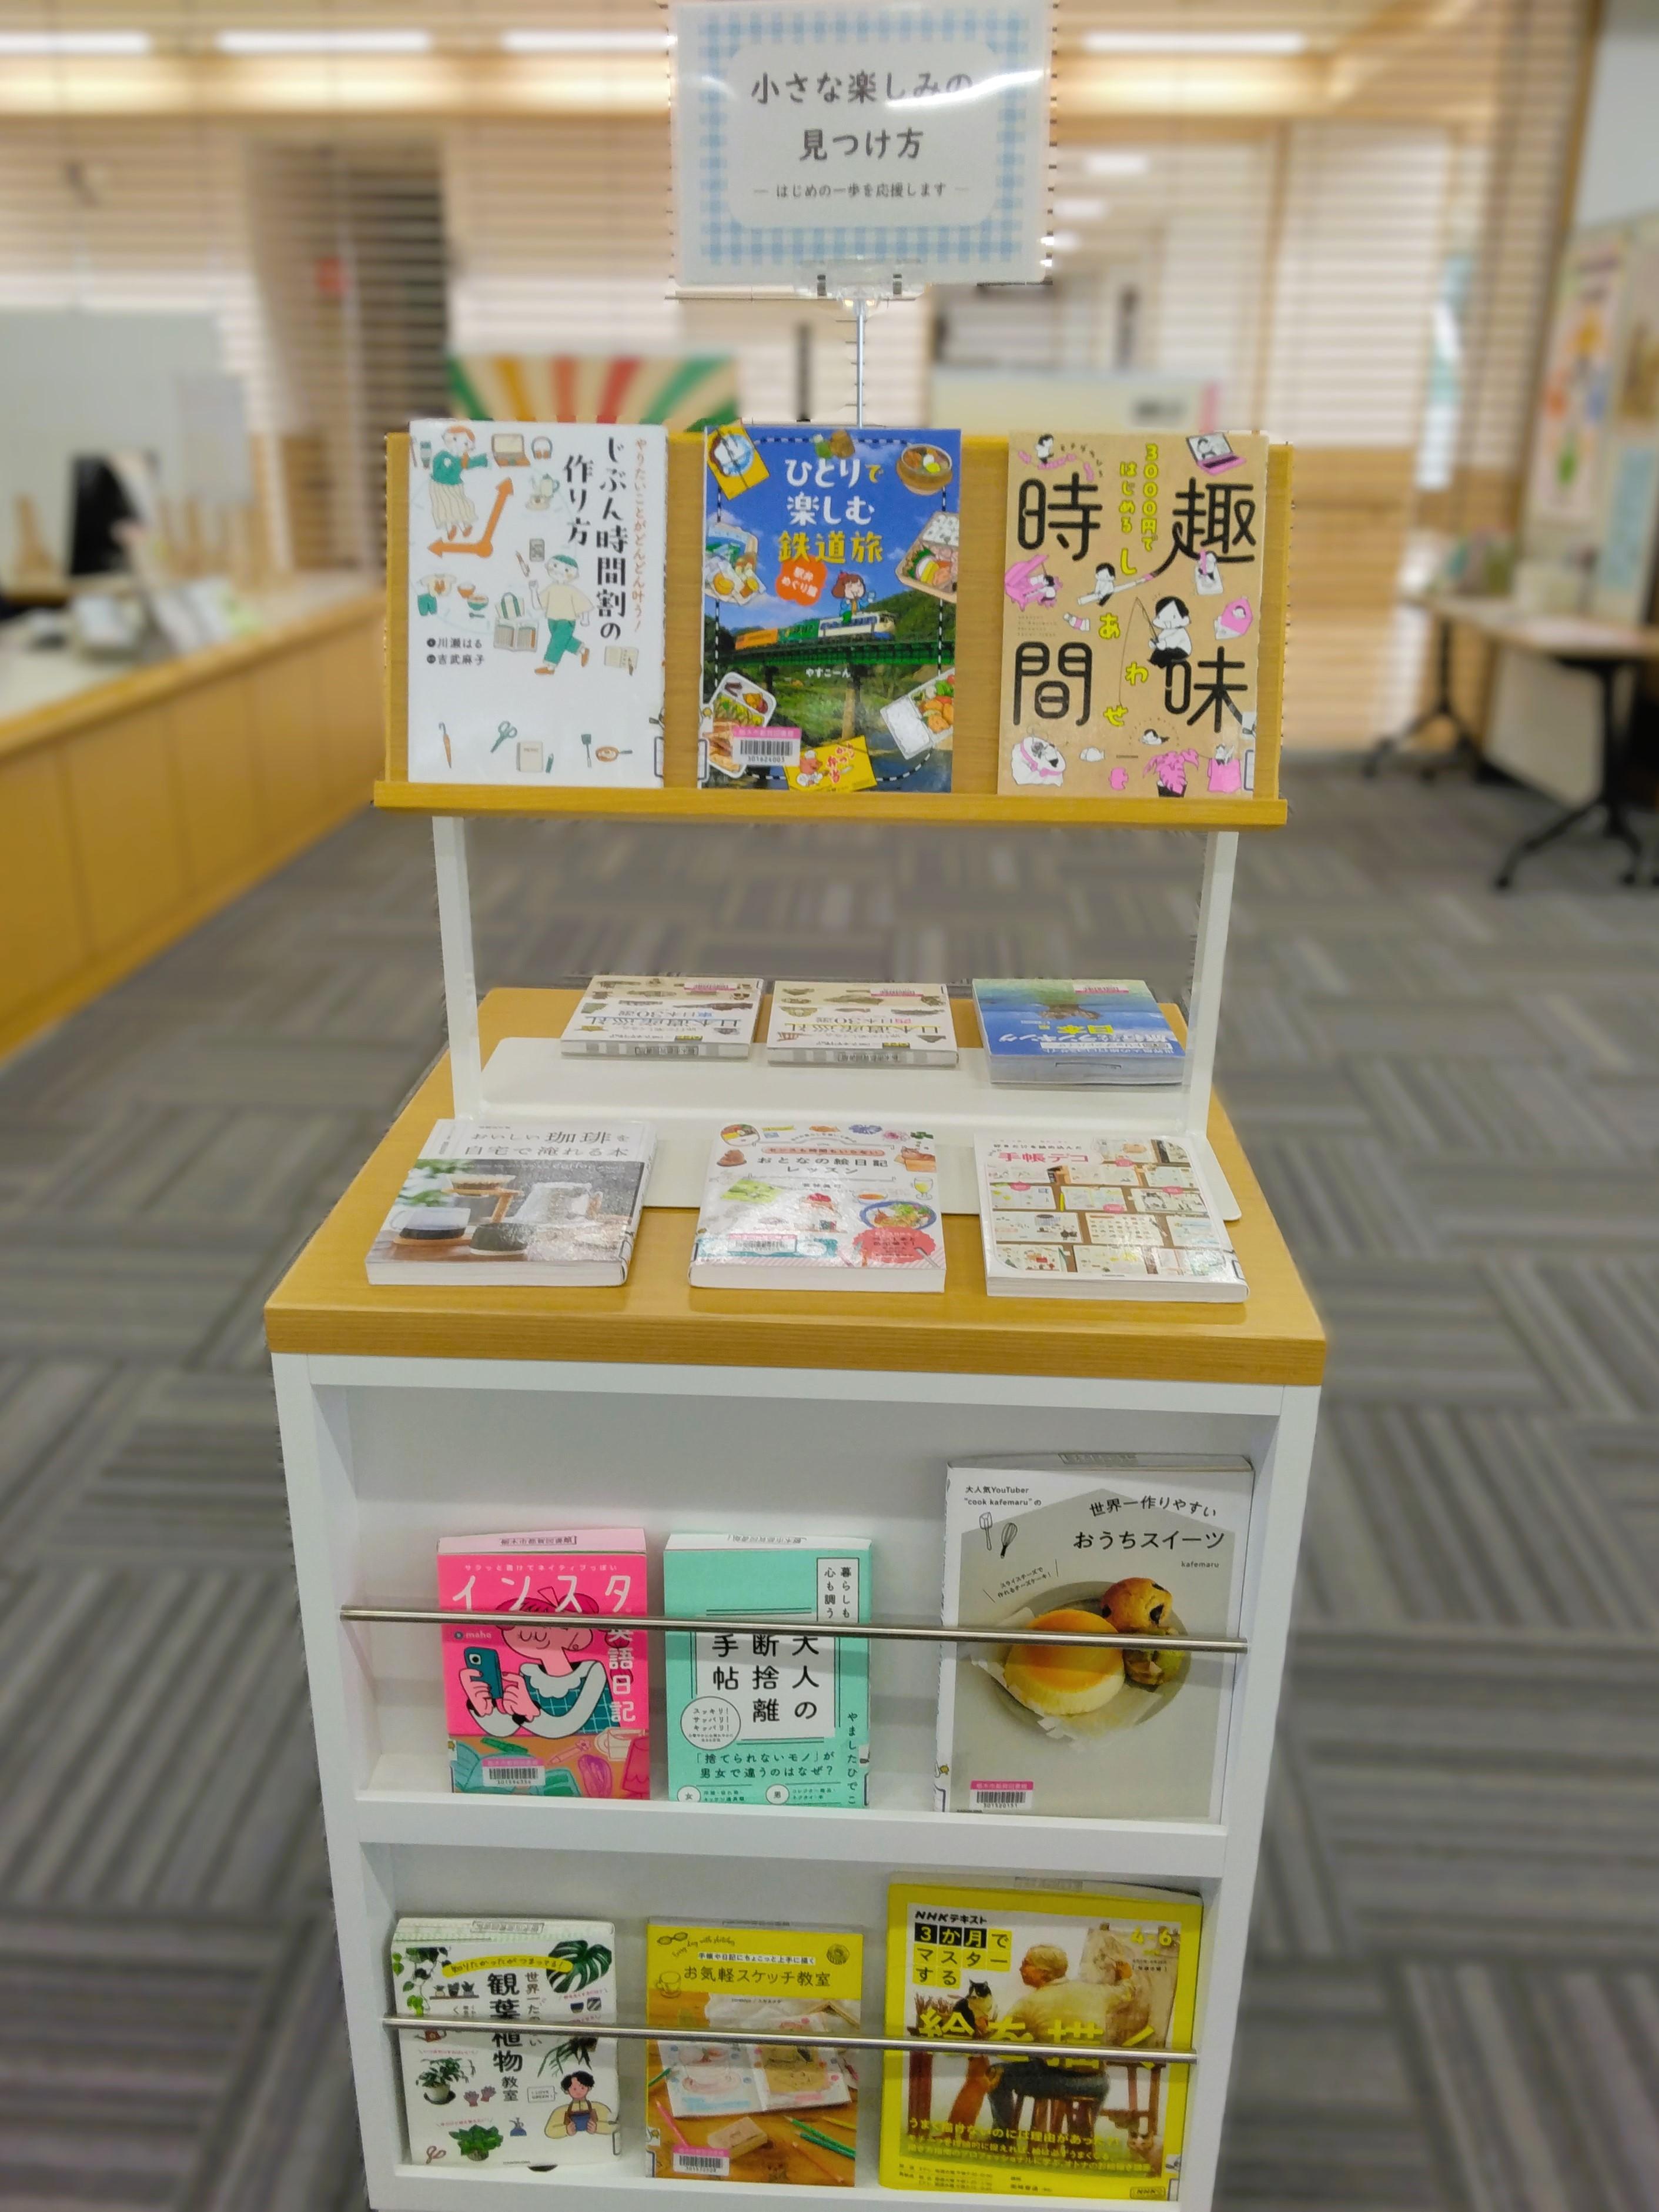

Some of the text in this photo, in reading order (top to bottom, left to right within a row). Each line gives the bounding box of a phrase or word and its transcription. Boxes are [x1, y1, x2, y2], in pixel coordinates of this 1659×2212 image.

[751, 70, 974, 104] 小さな楽しみの
[800, 128, 924, 161] 見つけ方
[775, 182, 946, 198] はじめの一歩を応援します
[785, 458, 884, 489] ひとりで
[563, 454, 594, 547] 作り方
[787, 494, 875, 527] 楽しむ
[1119, 462, 1138, 534] はじめる
[1141, 443, 1158, 552] 3000円で
[596, 437, 628, 640] じぶん時間割の
[778, 530, 884, 564] 鉄道旅
[471, 1131, 631, 1145] おいしい珈琲を
[757, 1157, 889, 1168] おとなの絵日記
[787, 1165, 858, 1174] レッスン
[998, 1151, 1089, 1163] 手帳デコ
[965, 1486, 1029, 1495] 大人気YouTuber
[1089, 1495, 1216, 1518] 世界一作りやすい
[1073, 1530, 1225, 1550] おうちスイーツ
[1181, 1561, 1220, 1569] kafemaru
[453, 1575, 632, 1614] インスタ
[824, 1566, 836, 1619] 心も調う
[840, 1566, 852, 1619] 暮らしも
[607, 1628, 636, 1723] 英語日記
[711, 1633, 740, 1691] 手帖
[752, 1633, 781, 1724] 断捨離
[791, 1636, 820, 1720] 大人の
[696, 1750, 835, 1765] 「捨てられないモノ」が
[700, 1765, 834, 1779] 男女で違うのはなぜ?
[847, 1712, 859, 1805] やましたひでこ
[915, 1910, 988, 1925] NHKテキスト
[919, 1926, 1010, 1949] 3か月で
[917, 1947, 1008, 1967] マスター
[684, 1966, 831, 1988] お気軽スケッチ教室
[915, 1966, 957, 1986] する
